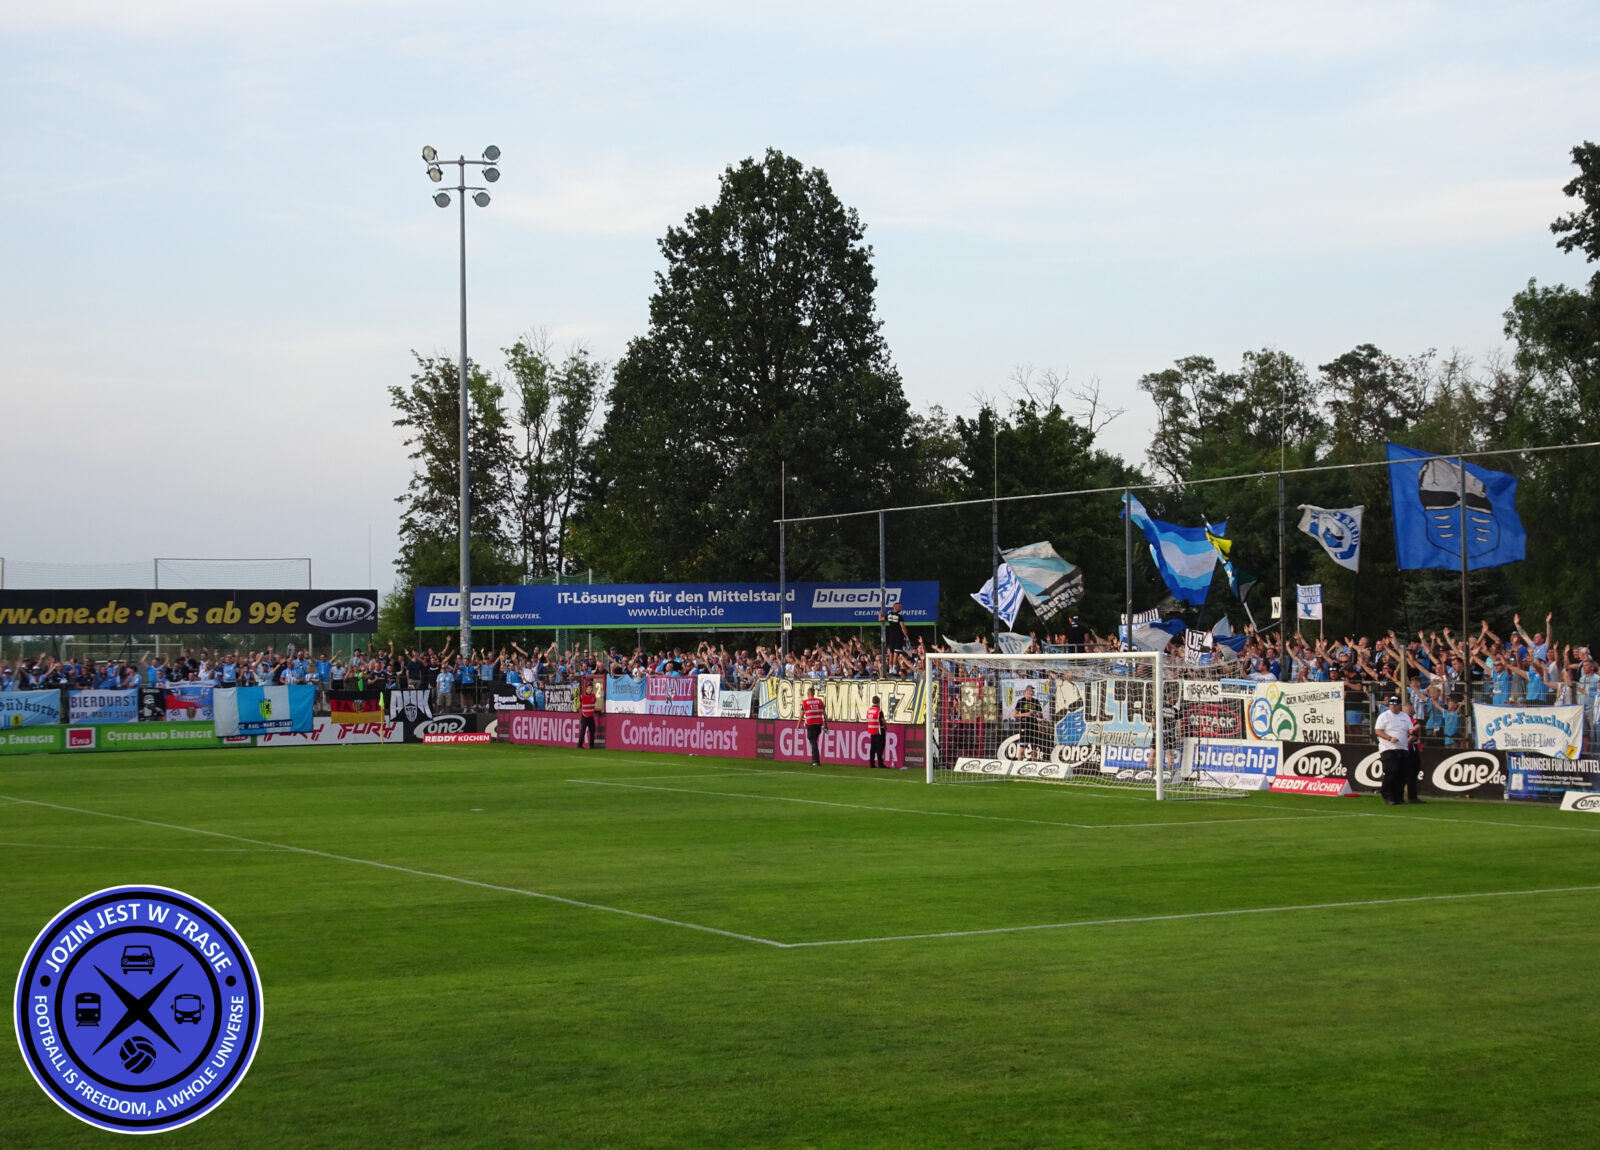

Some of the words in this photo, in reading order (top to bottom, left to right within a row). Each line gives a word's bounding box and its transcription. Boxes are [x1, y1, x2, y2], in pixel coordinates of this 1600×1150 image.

[430, 595, 512, 609] bluchip
[557, 592, 644, 606] IT-Lösungen
[649, 591, 672, 603] für
[676, 591, 703, 603] den
[708, 589, 796, 603] Mittelstand
[816, 590, 898, 605] bluechp
[148, 602, 199, 625] PCs
[205, 601, 242, 624] ab
[248, 602, 299, 624] 99€
[627, 606, 725, 618] www.bluechip.de
[785, 617, 791, 627] M
[595, 682, 602, 698] 2
[649, 678, 693, 696] CHEMNITZ
[71, 696, 137, 708] BIERDURST
[1303, 713, 1324, 725] Gast
[1485, 712, 1572, 738] CFC-Fanclub
[170, 730, 212, 739] ENERGIE
[424, 735, 456, 743] REDDY
[458, 734, 490, 742] KÜCHEN
[621, 719, 738, 751] Containerdienst
[780, 727, 898, 762] GEWENIGR
[1194, 746, 1276, 774] bluechip
[1272, 778, 1307, 791] REDDY
[1307, 780, 1343, 793] KÜCHEN
